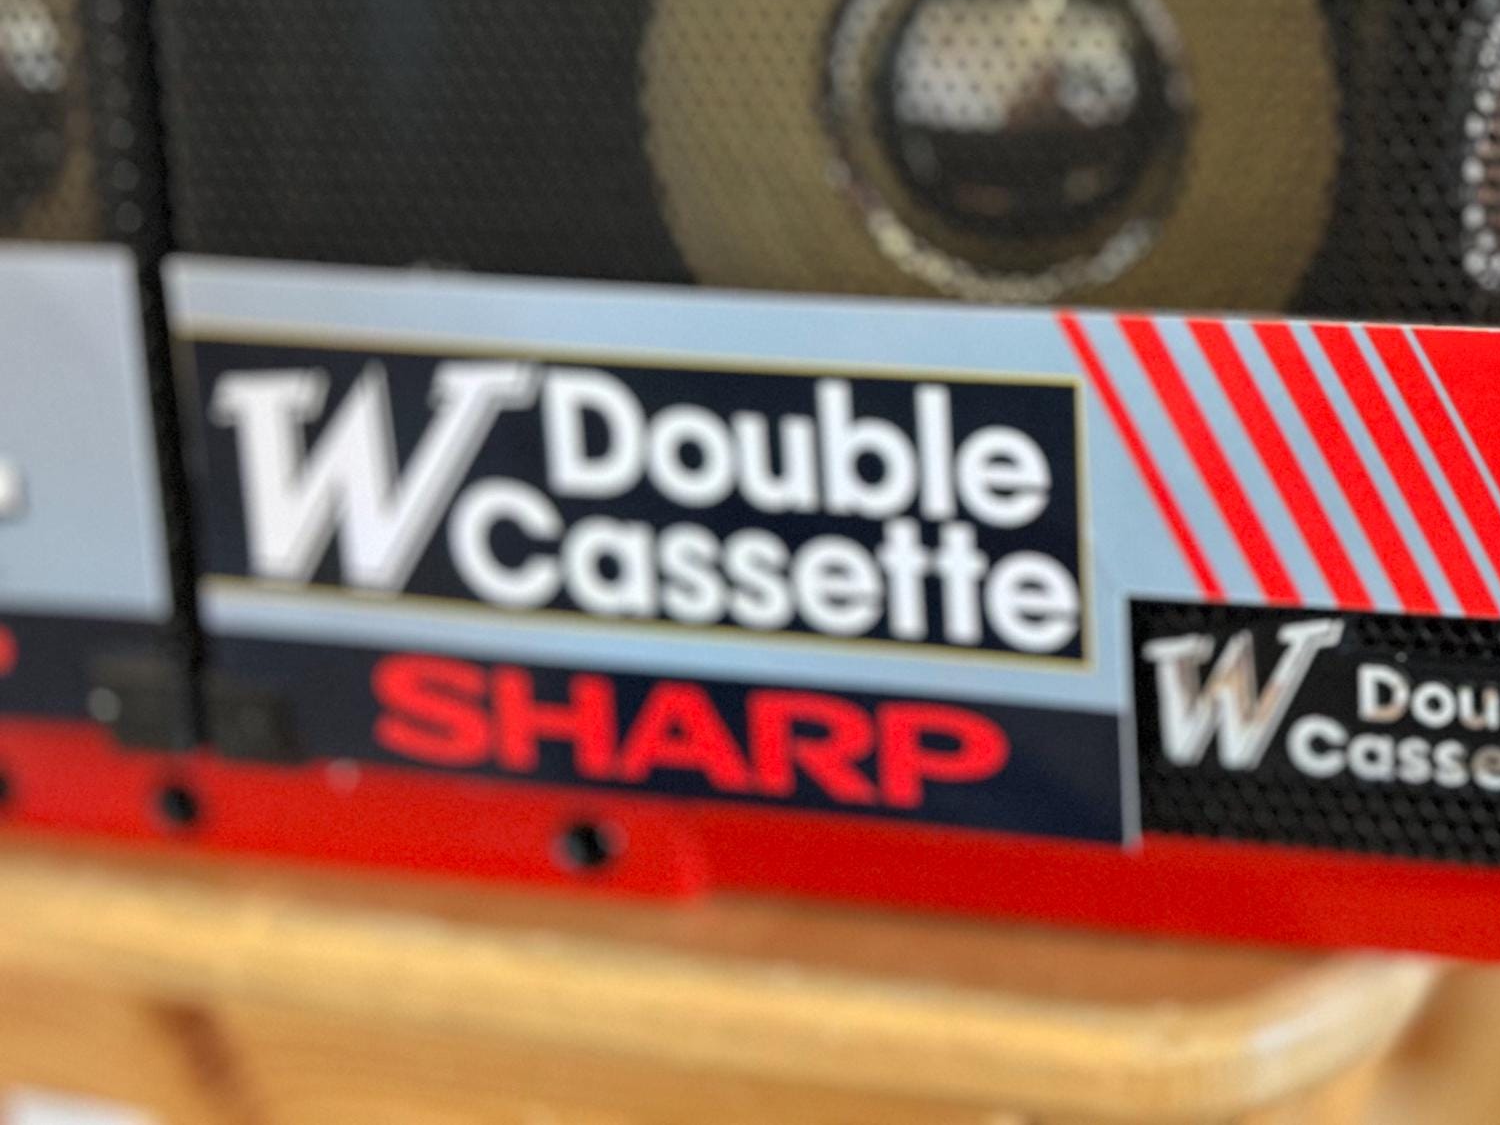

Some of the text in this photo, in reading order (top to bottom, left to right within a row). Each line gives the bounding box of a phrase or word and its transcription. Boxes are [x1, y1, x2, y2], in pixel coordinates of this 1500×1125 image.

[211, 359, 540, 594] W
[541, 367, 1053, 530] Double
[449, 477, 1081, 655] Cassette
[371, 651, 1010, 810] SHARP
[1141, 617, 1346, 771] W
